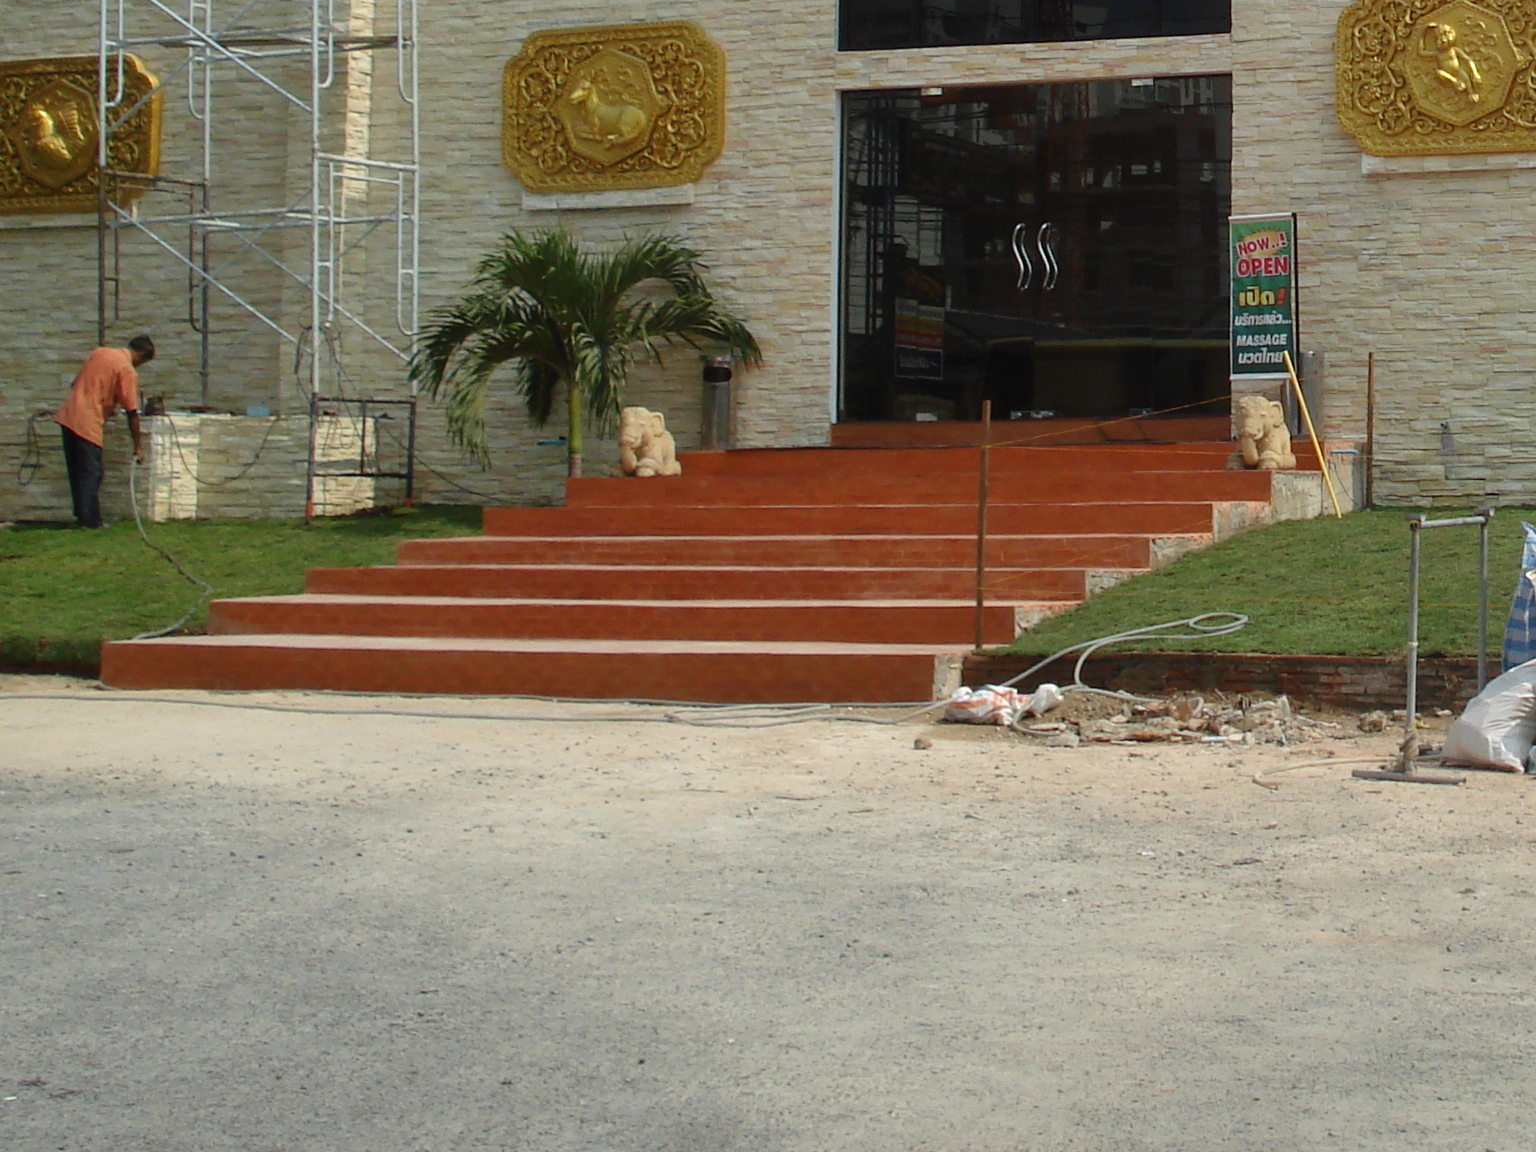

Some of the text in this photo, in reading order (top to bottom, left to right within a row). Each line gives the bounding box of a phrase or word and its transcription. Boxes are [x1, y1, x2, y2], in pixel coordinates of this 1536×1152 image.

[1238, 256, 1289, 276] OPEN
[1236, 333, 1288, 347] MASSAGE
[1238, 347, 1284, 364] นวดไทย
